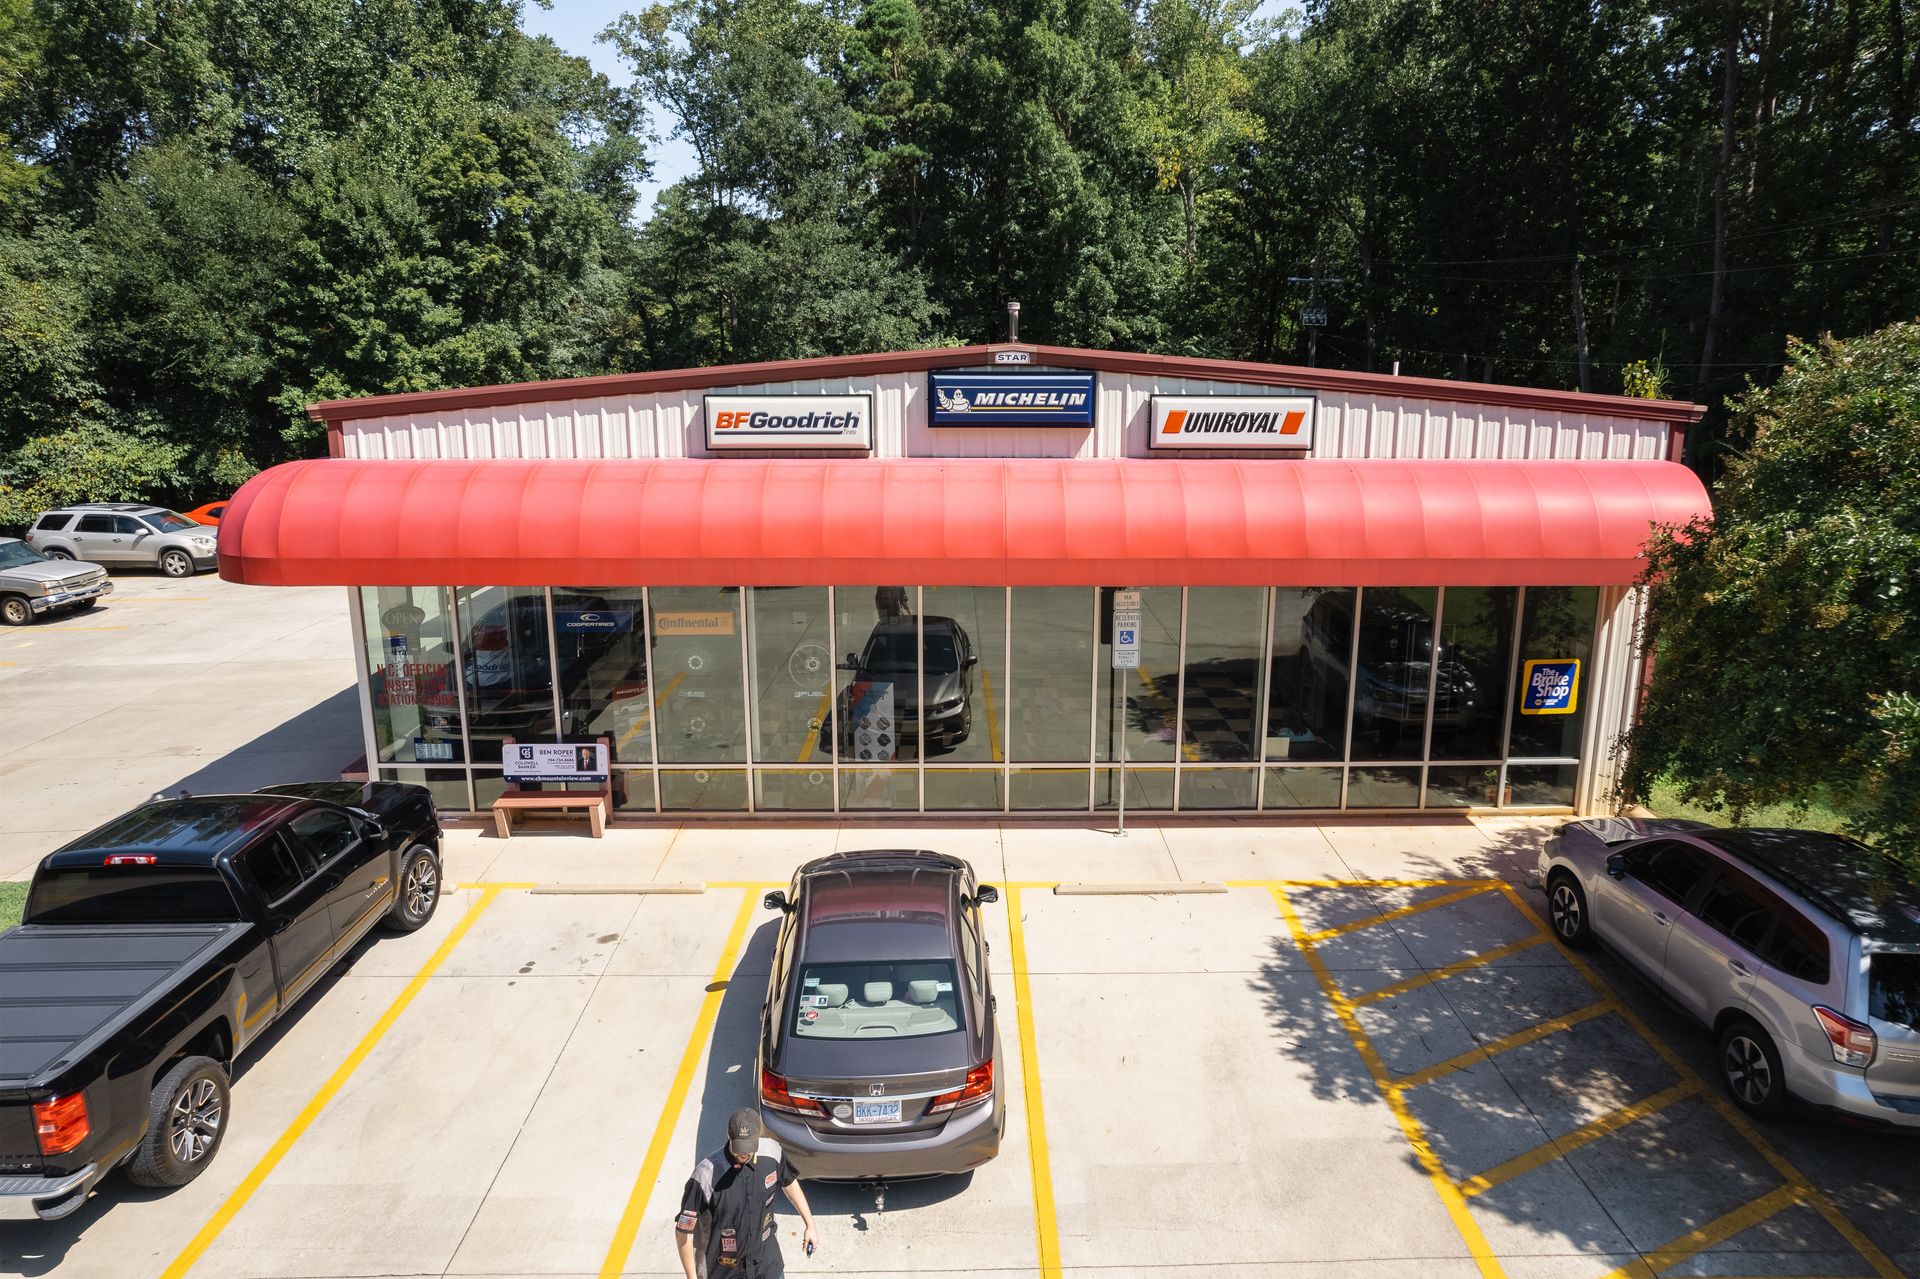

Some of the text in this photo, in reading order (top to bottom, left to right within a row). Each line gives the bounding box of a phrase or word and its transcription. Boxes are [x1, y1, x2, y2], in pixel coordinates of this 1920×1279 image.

[997, 353, 1028, 363] STAR
[974, 390, 1088, 406] MICHELIN
[715, 411, 860, 429] BFGoodrich
[1184, 412, 1280, 433] UNIROYAL
[385, 612, 418, 625] OPEN
[658, 617, 719, 630] Continental
[1532, 672, 1569, 686] Brake
[1536, 684, 1569, 699] Shop
[378, 694, 417, 705] STATION
